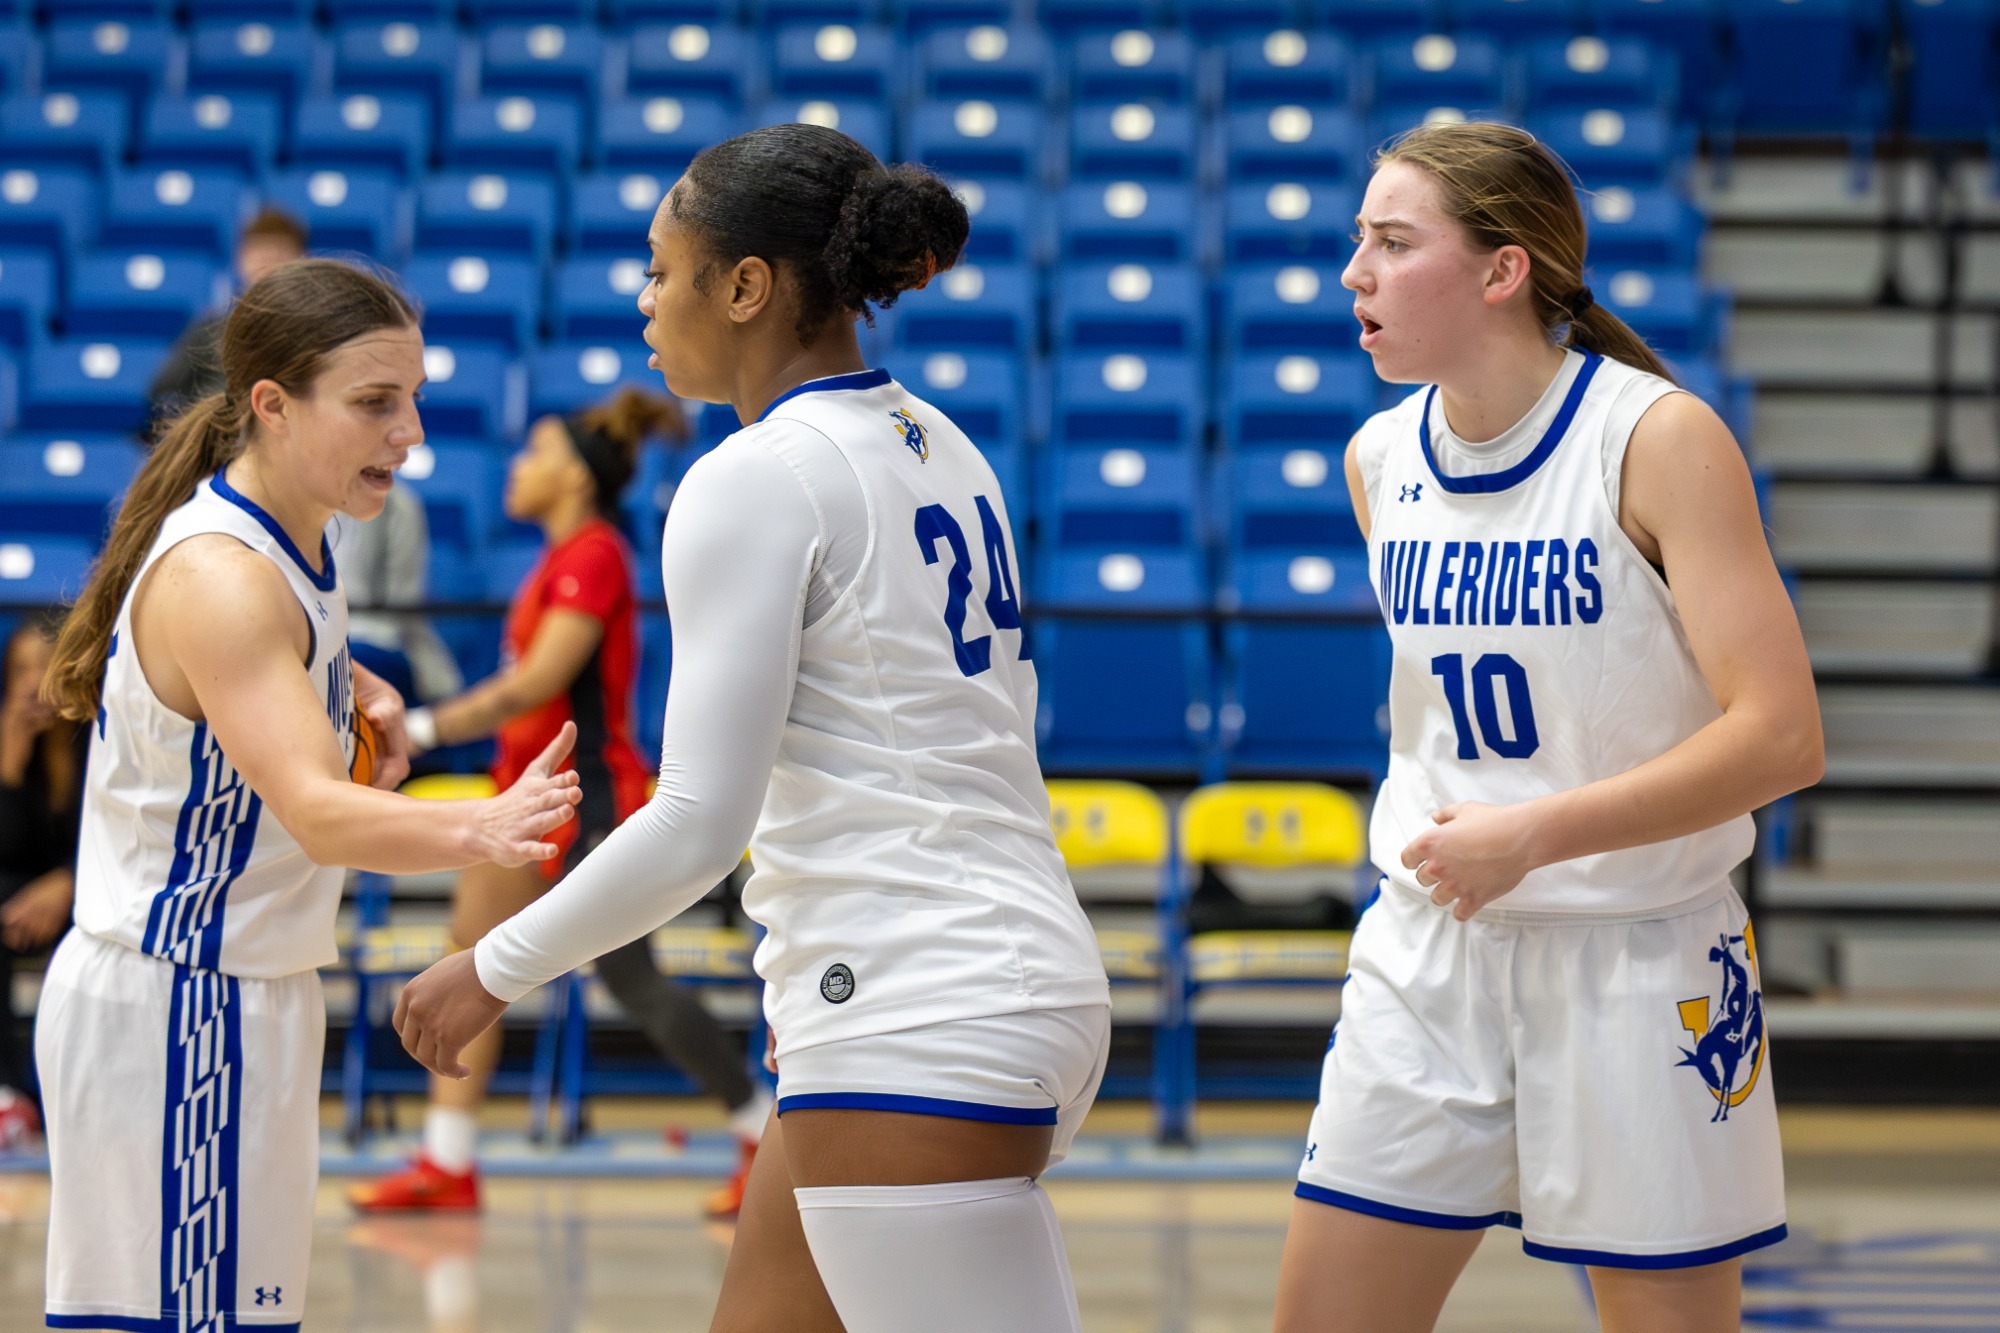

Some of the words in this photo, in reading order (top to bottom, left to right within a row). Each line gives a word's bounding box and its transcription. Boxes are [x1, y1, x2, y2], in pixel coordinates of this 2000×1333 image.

[914, 495, 1031, 677] 24
[1381, 537, 1604, 625] MULERIDERS
[1431, 653, 1540, 761] 10
[829, 975, 844, 986] MD
